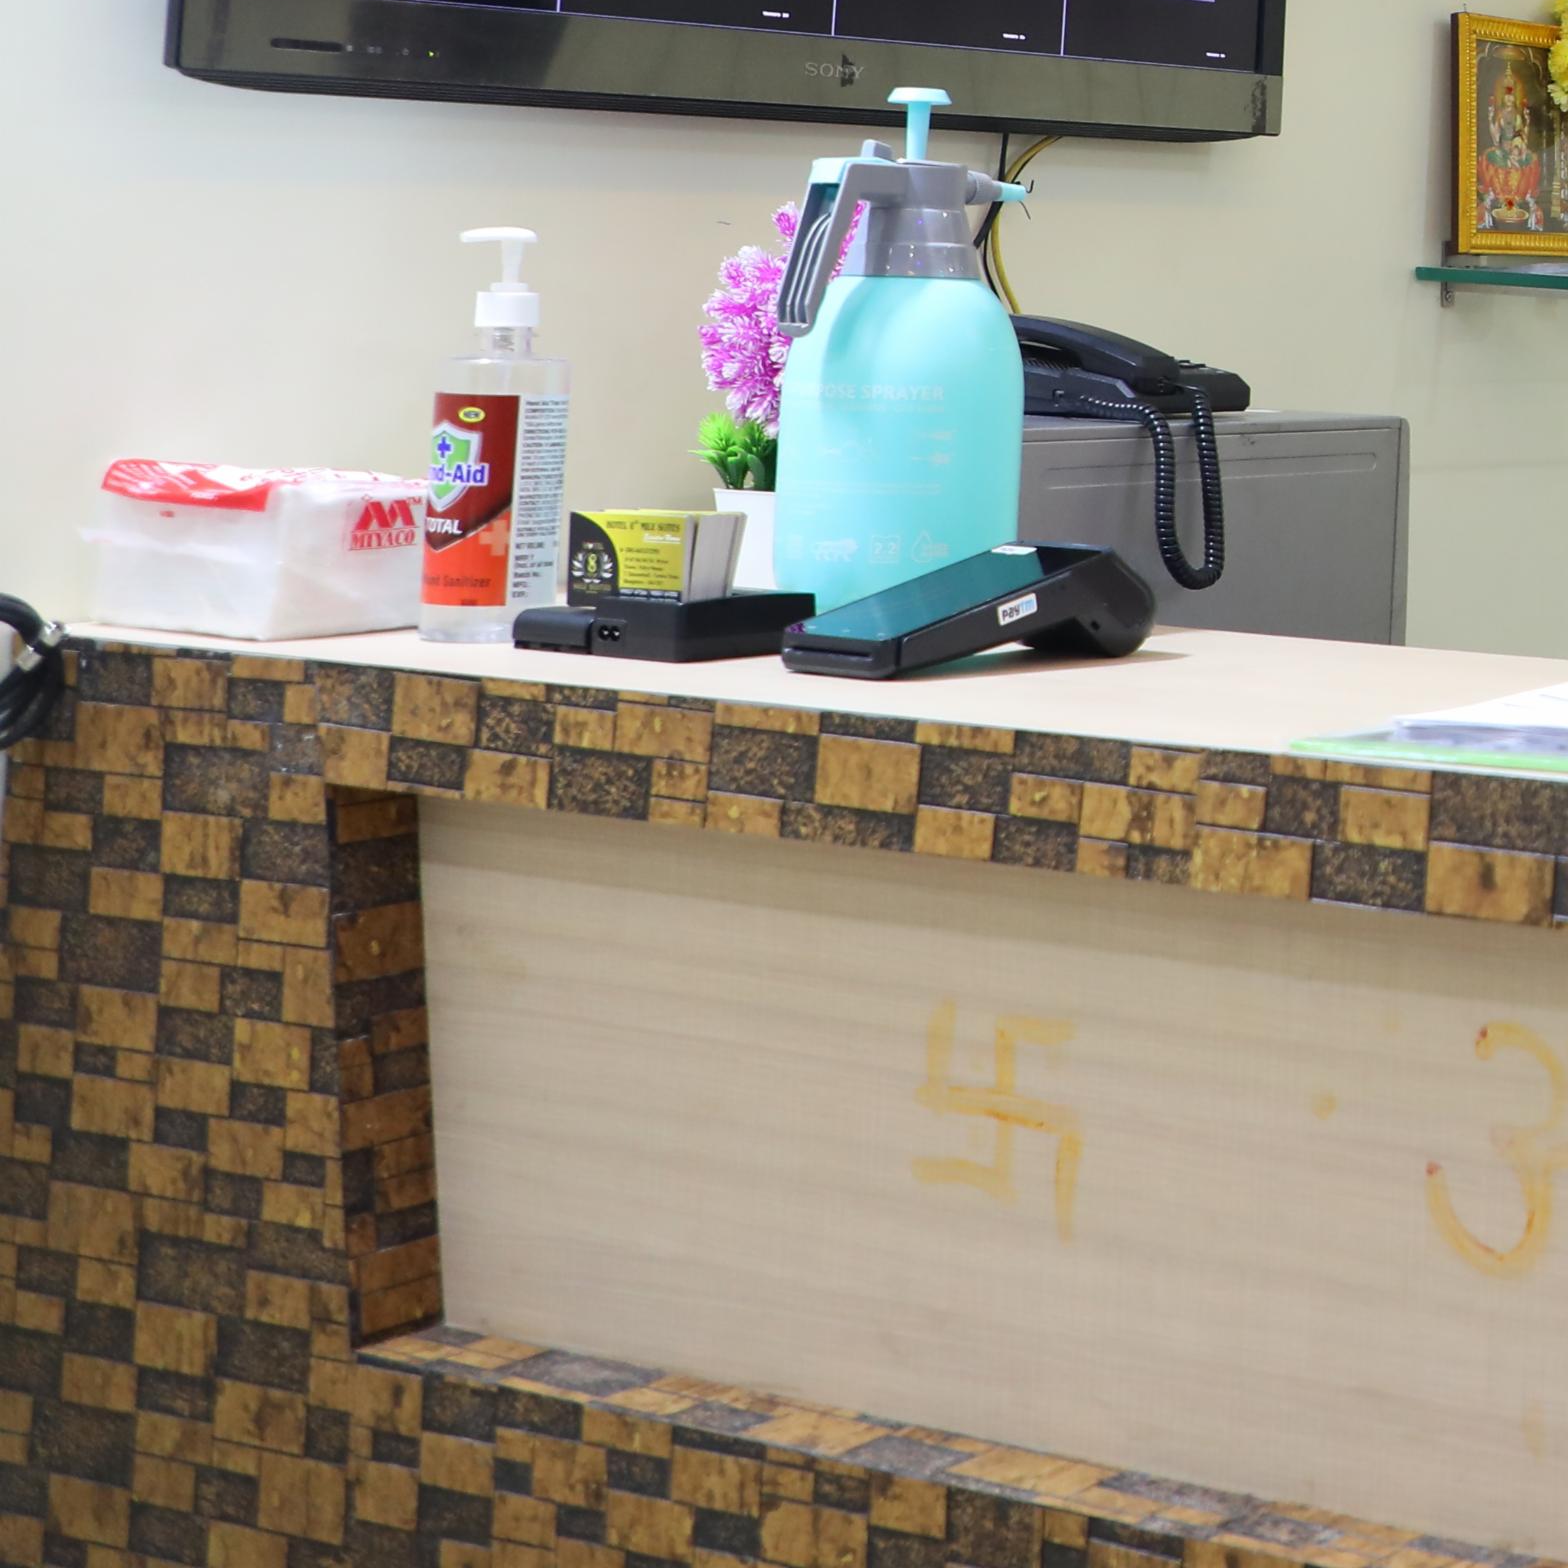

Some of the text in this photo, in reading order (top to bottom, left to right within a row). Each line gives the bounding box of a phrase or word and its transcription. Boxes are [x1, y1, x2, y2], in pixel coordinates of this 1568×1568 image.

[805, 62, 864, 80] SONY
[862, 384, 945, 401] SPRAYER
[351, 530, 415, 548] MIYACO
